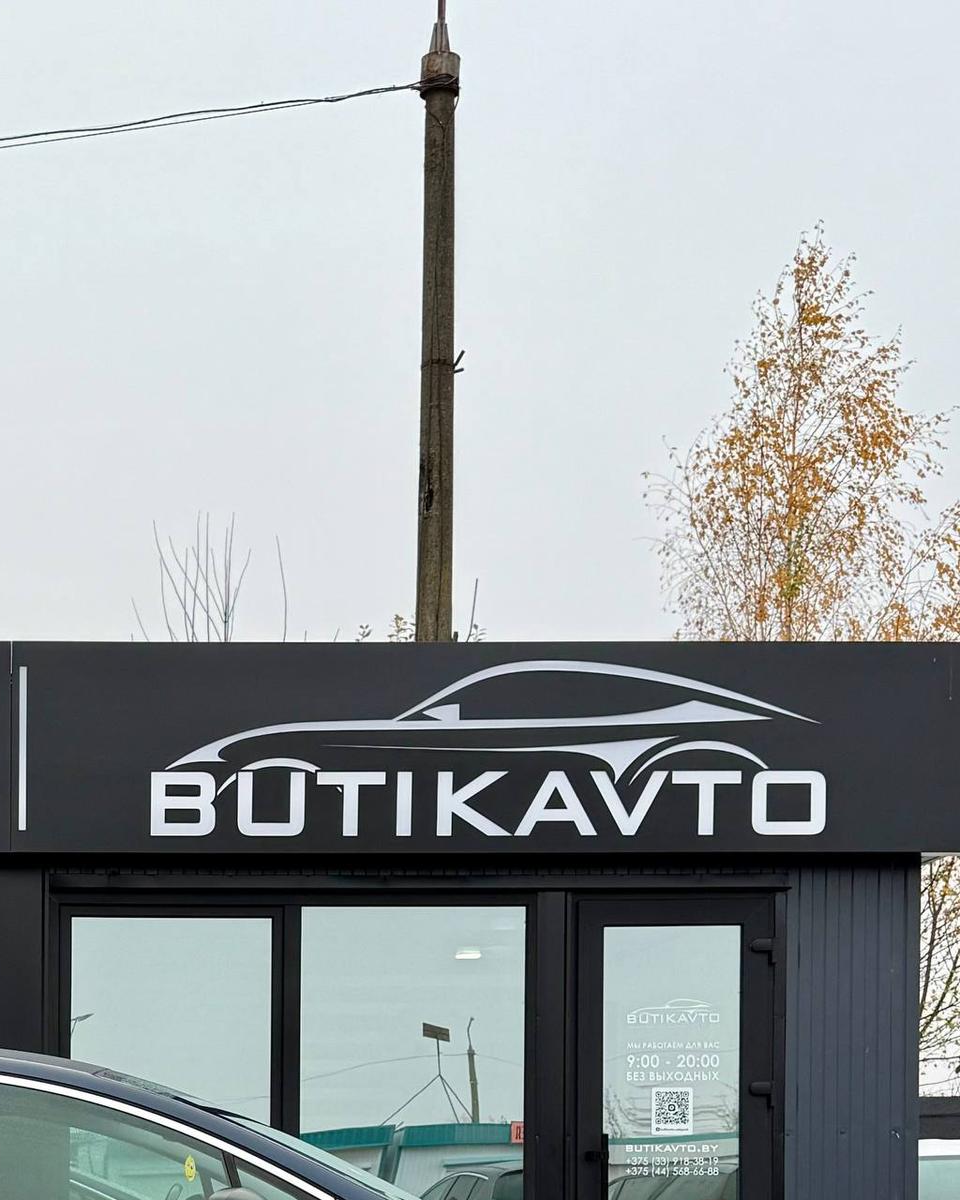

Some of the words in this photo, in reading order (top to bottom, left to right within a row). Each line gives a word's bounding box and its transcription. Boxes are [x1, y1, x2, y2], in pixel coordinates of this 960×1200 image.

[150, 770, 827, 837] BUTIKAVTO
[627, 1012, 720, 1024] BUTIKAVTO
[627, 1054, 660, 1068] 9:00
[676, 1054, 720, 1068] 20:00
[626, 1071, 646, 1081] БЕЗ
[649, 1071, 720, 1082] ВЫХОДНЫХ
[625, 1144, 719, 1153] BUTIKAVTO.BY
[625, 1156, 649, 1166] +375
[651, 1156, 670, 1168] (33)
[625, 1166, 649, 1176] +375
[651, 1166, 670, 1178] (44)
